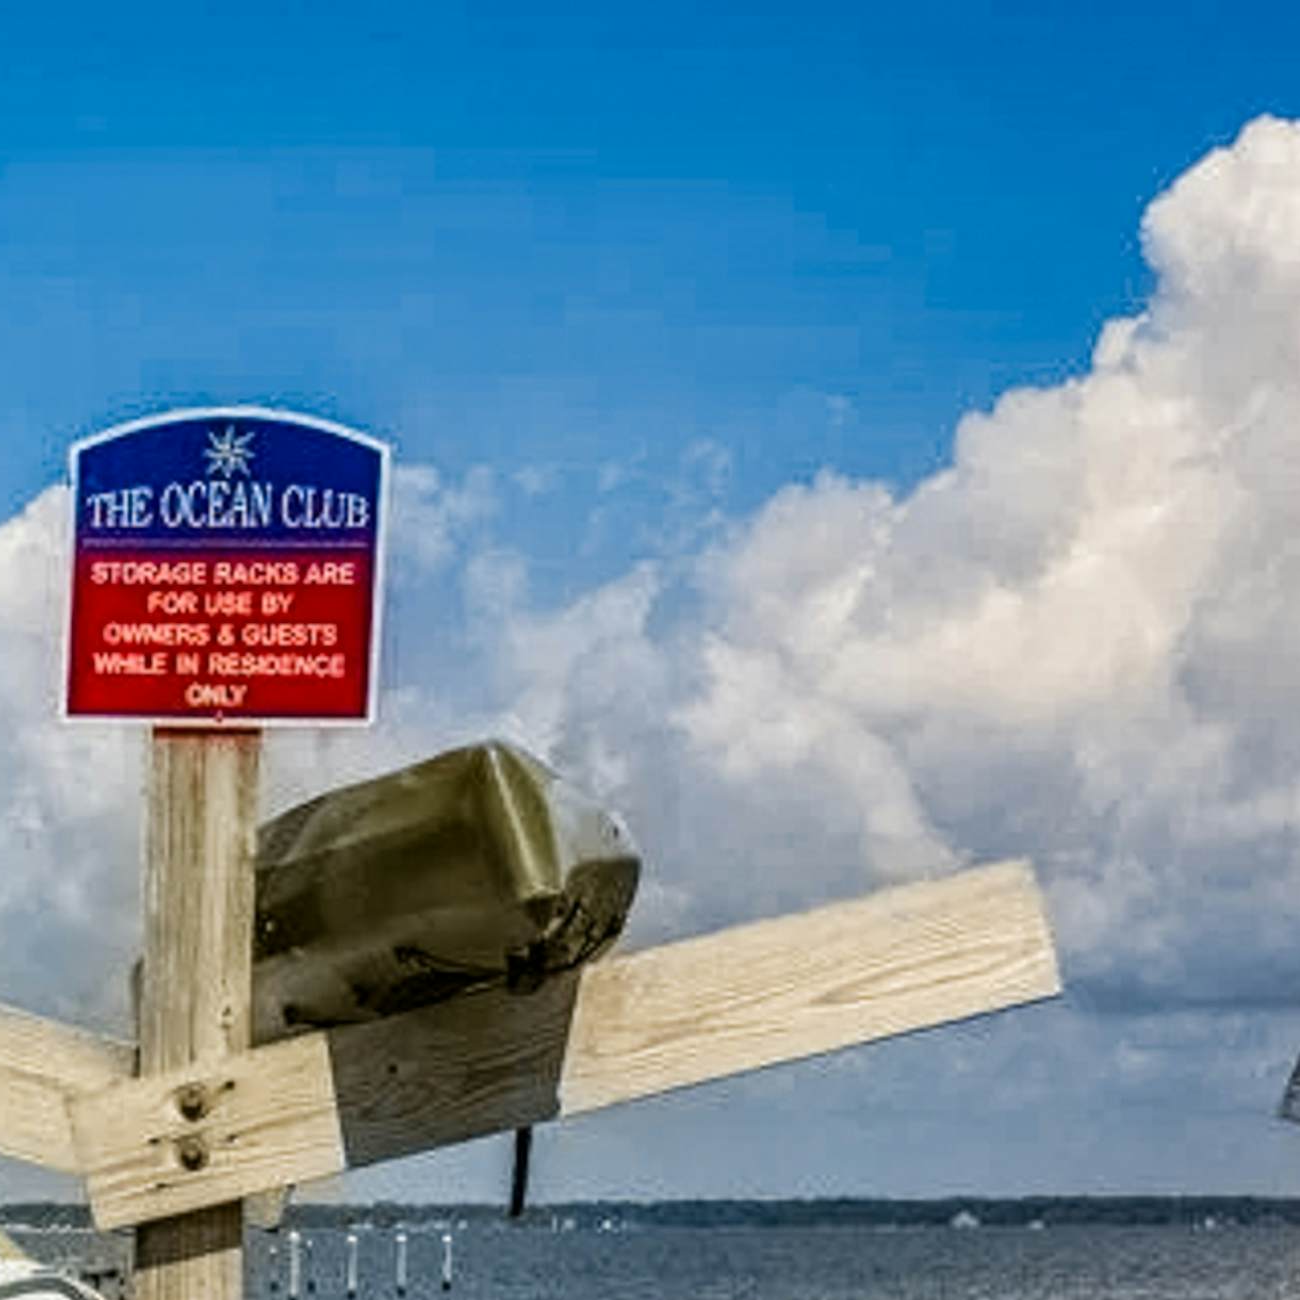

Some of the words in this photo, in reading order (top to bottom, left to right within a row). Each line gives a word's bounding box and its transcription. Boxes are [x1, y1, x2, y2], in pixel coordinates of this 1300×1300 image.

[87, 487, 153, 528] THE
[160, 481, 272, 528] OCEAN
[281, 485, 370, 528] CLUB
[91, 563, 206, 584] STORAGE
[214, 563, 298, 584] RACKS
[304, 563, 355, 584] ARE
[147, 592, 197, 614] FOR
[204, 593, 252, 615] USE
[262, 593, 295, 613] BY
[103, 623, 210, 645] OWNERS
[217, 624, 235, 645] &
[242, 624, 337, 646] GUESTS
[93, 653, 167, 674] WHILE
[177, 654, 198, 674] IN
[208, 654, 345, 677] RESIDENCE
[185, 685, 247, 705] ONLY
